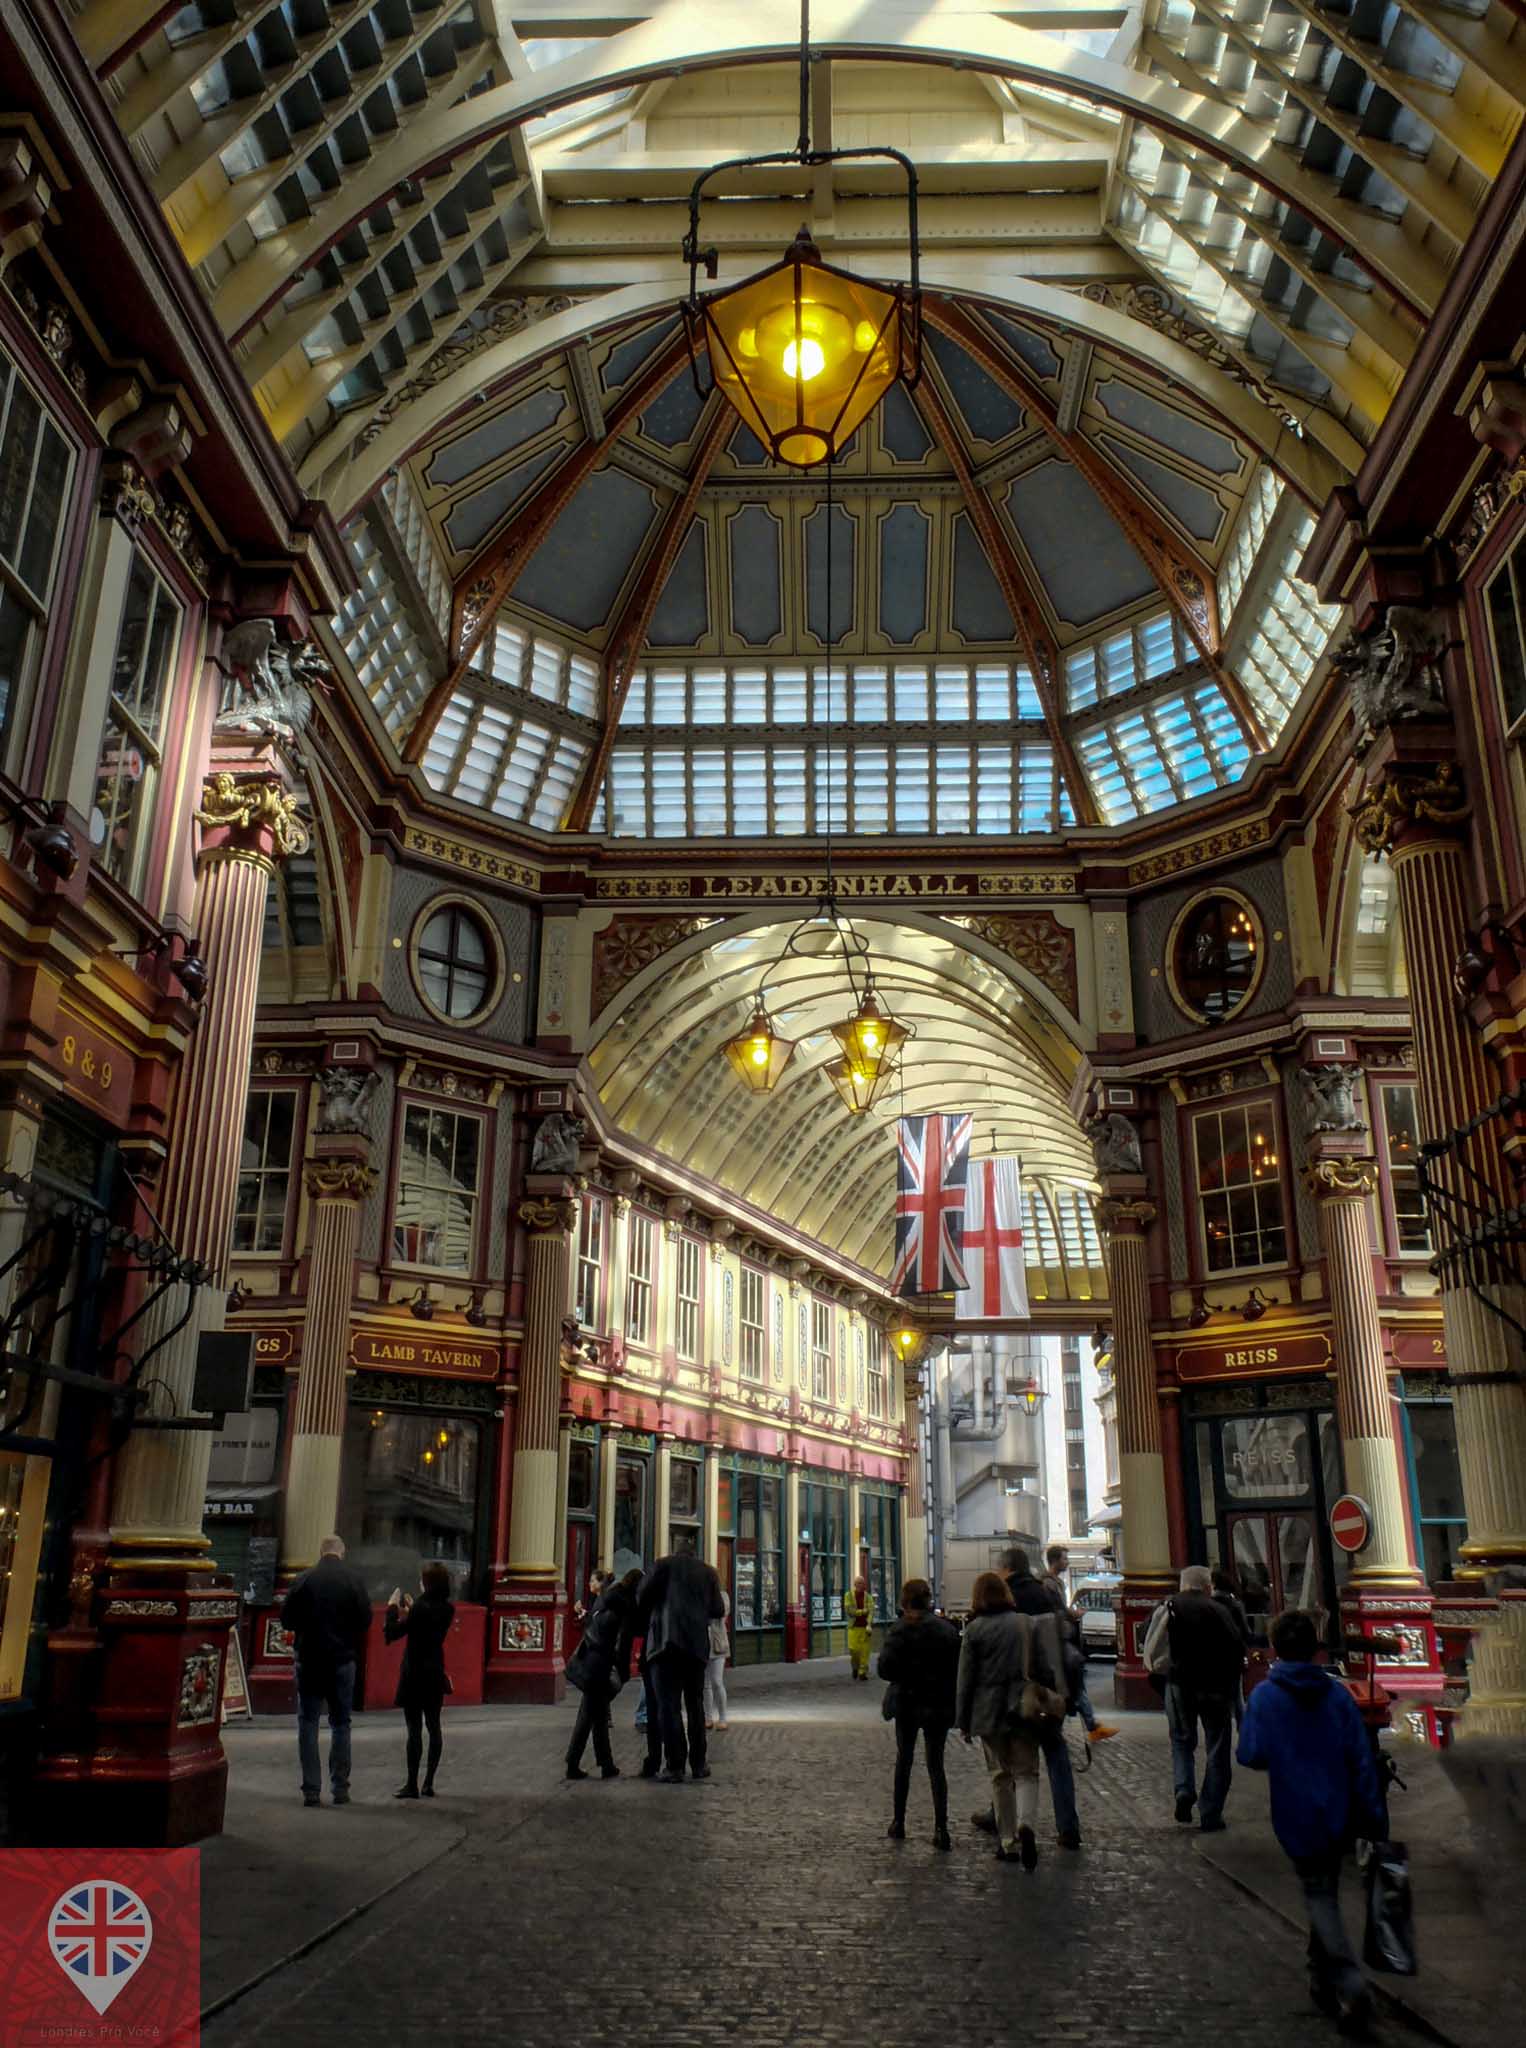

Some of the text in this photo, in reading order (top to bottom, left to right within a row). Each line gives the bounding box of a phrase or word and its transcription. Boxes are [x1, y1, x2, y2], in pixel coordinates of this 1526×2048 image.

[704, 875, 968, 896] LEADENHALL
[63, 1036, 112, 1088] 8 & 9
[370, 1343, 482, 1368] LAMB TAVERN
[1432, 1339, 1448, 1353] 2
[1225, 1348, 1278, 1367] REISS
[1232, 1450, 1296, 1468] REISS
[223, 1503, 254, 1514] BAR
